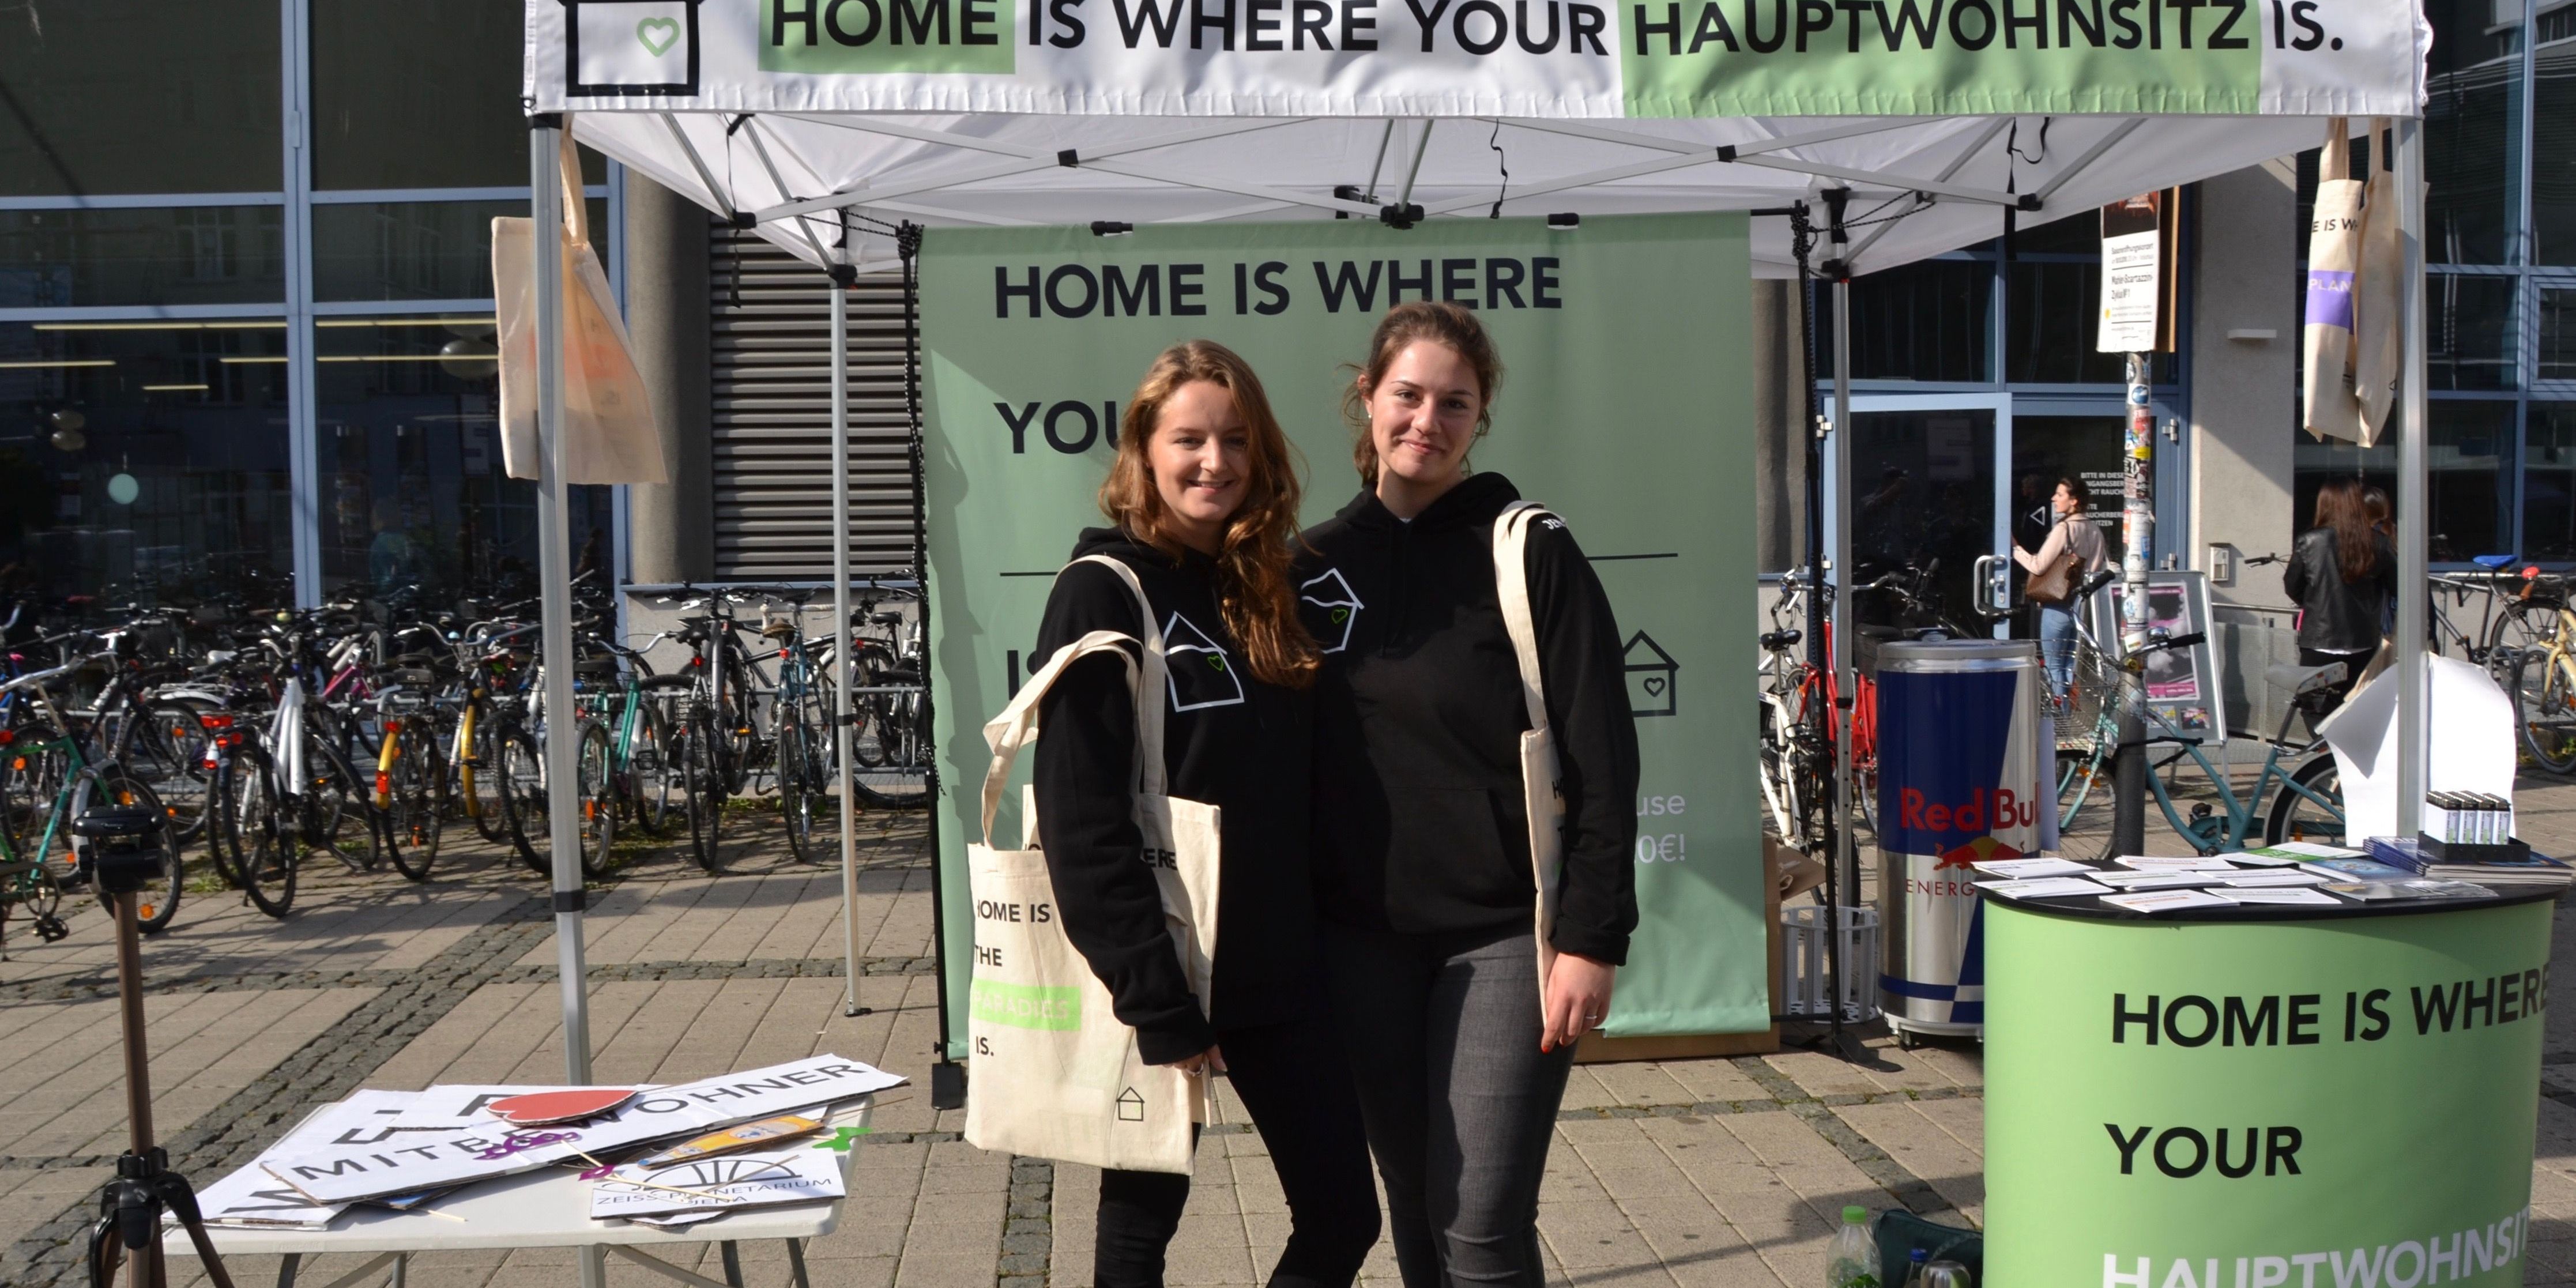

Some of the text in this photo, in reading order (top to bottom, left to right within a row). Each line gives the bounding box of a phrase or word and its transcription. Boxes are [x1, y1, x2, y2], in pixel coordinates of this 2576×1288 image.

[771, 0, 2344, 56] HOME IS WHERE YOUR HAUPTWOHNSITZ IS.
[995, 257, 1562, 319] HOME IS WHERE
[993, 400, 1121, 454] YO
[1637, 795, 1686, 816] use
[1900, 788, 1984, 831] Red
[1143, 848, 1177, 871] ERE
[1637, 834, 1686, 864] 0€!
[1906, 879, 1975, 896] ENERG
[1030, 903, 1050, 922] IS
[2112, 992, 2320, 1048] HOME
[2344, 989, 2390, 1042] IS
[976, 1036, 994, 1056] IS.
[2104, 1123, 2302, 1178] YOUR
[2102, 1205, 2531, 1288] HAUPTWOHNSIT
